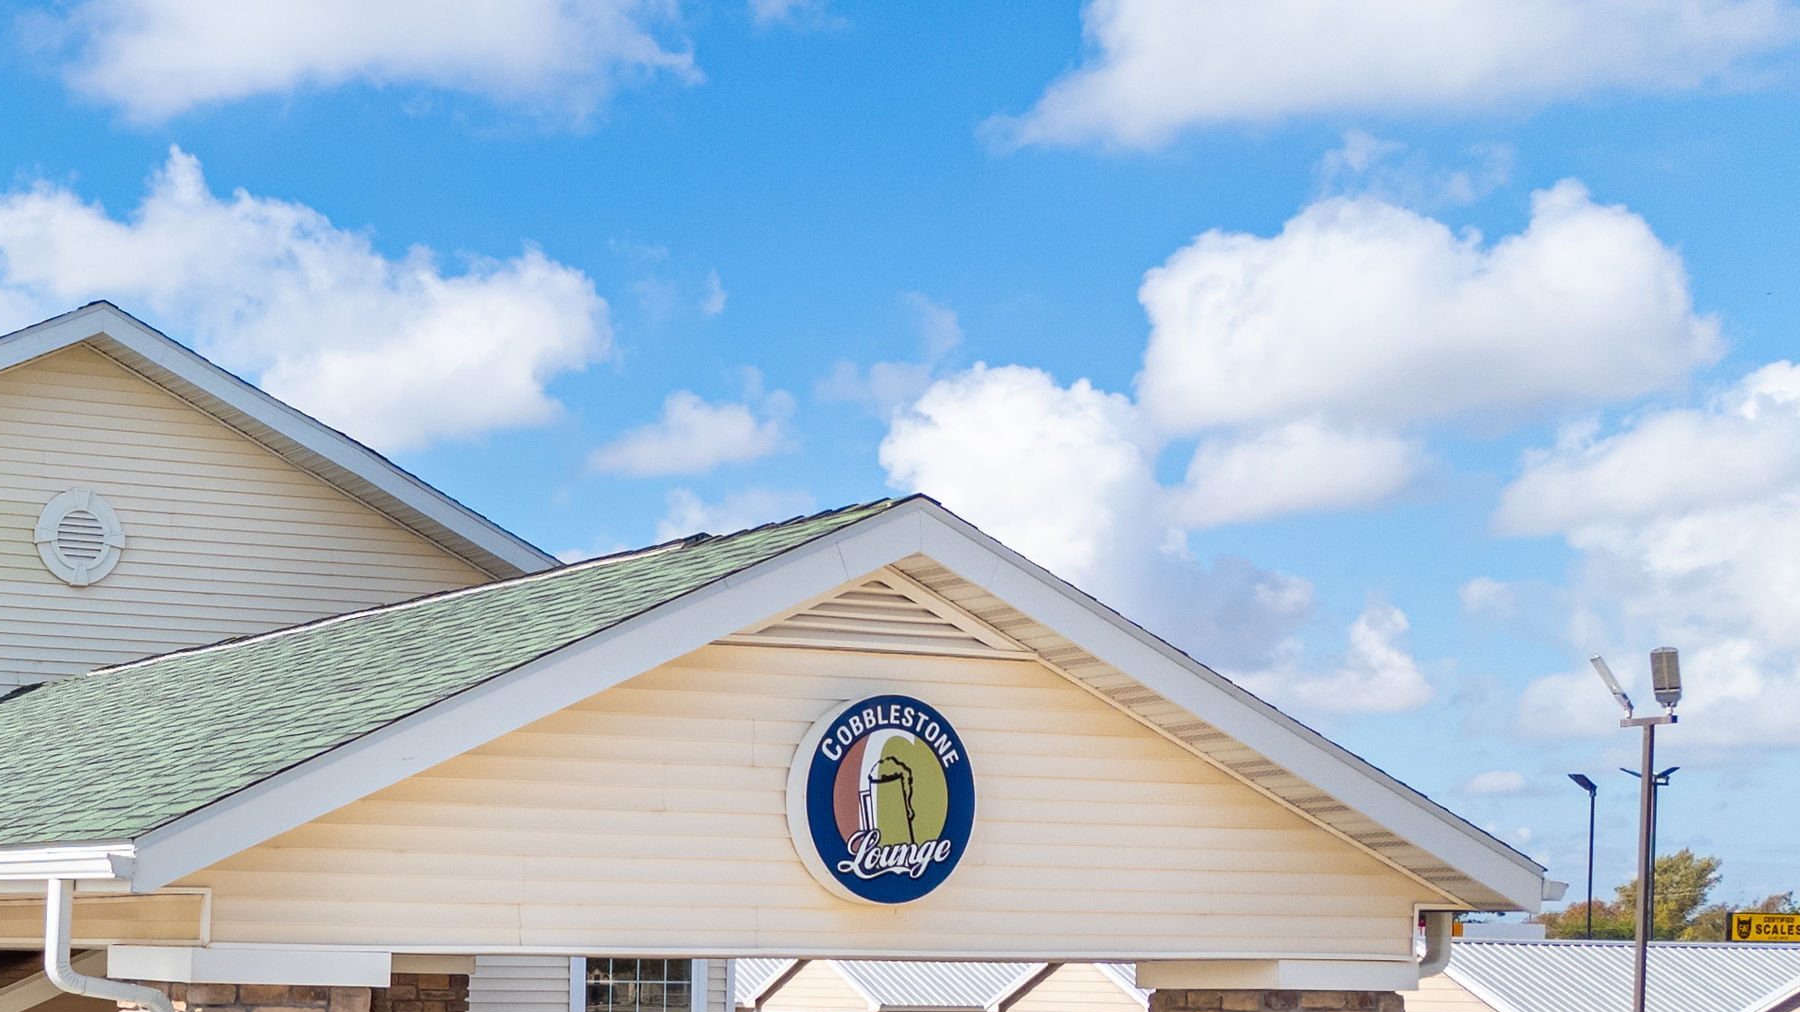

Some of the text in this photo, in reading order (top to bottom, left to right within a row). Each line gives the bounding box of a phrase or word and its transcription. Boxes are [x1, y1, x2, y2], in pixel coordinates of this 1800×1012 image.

[821, 704, 960, 769] COBBLESTONE
[837, 829, 952, 879] Lounge
[1755, 923, 1800, 936] SCALES
